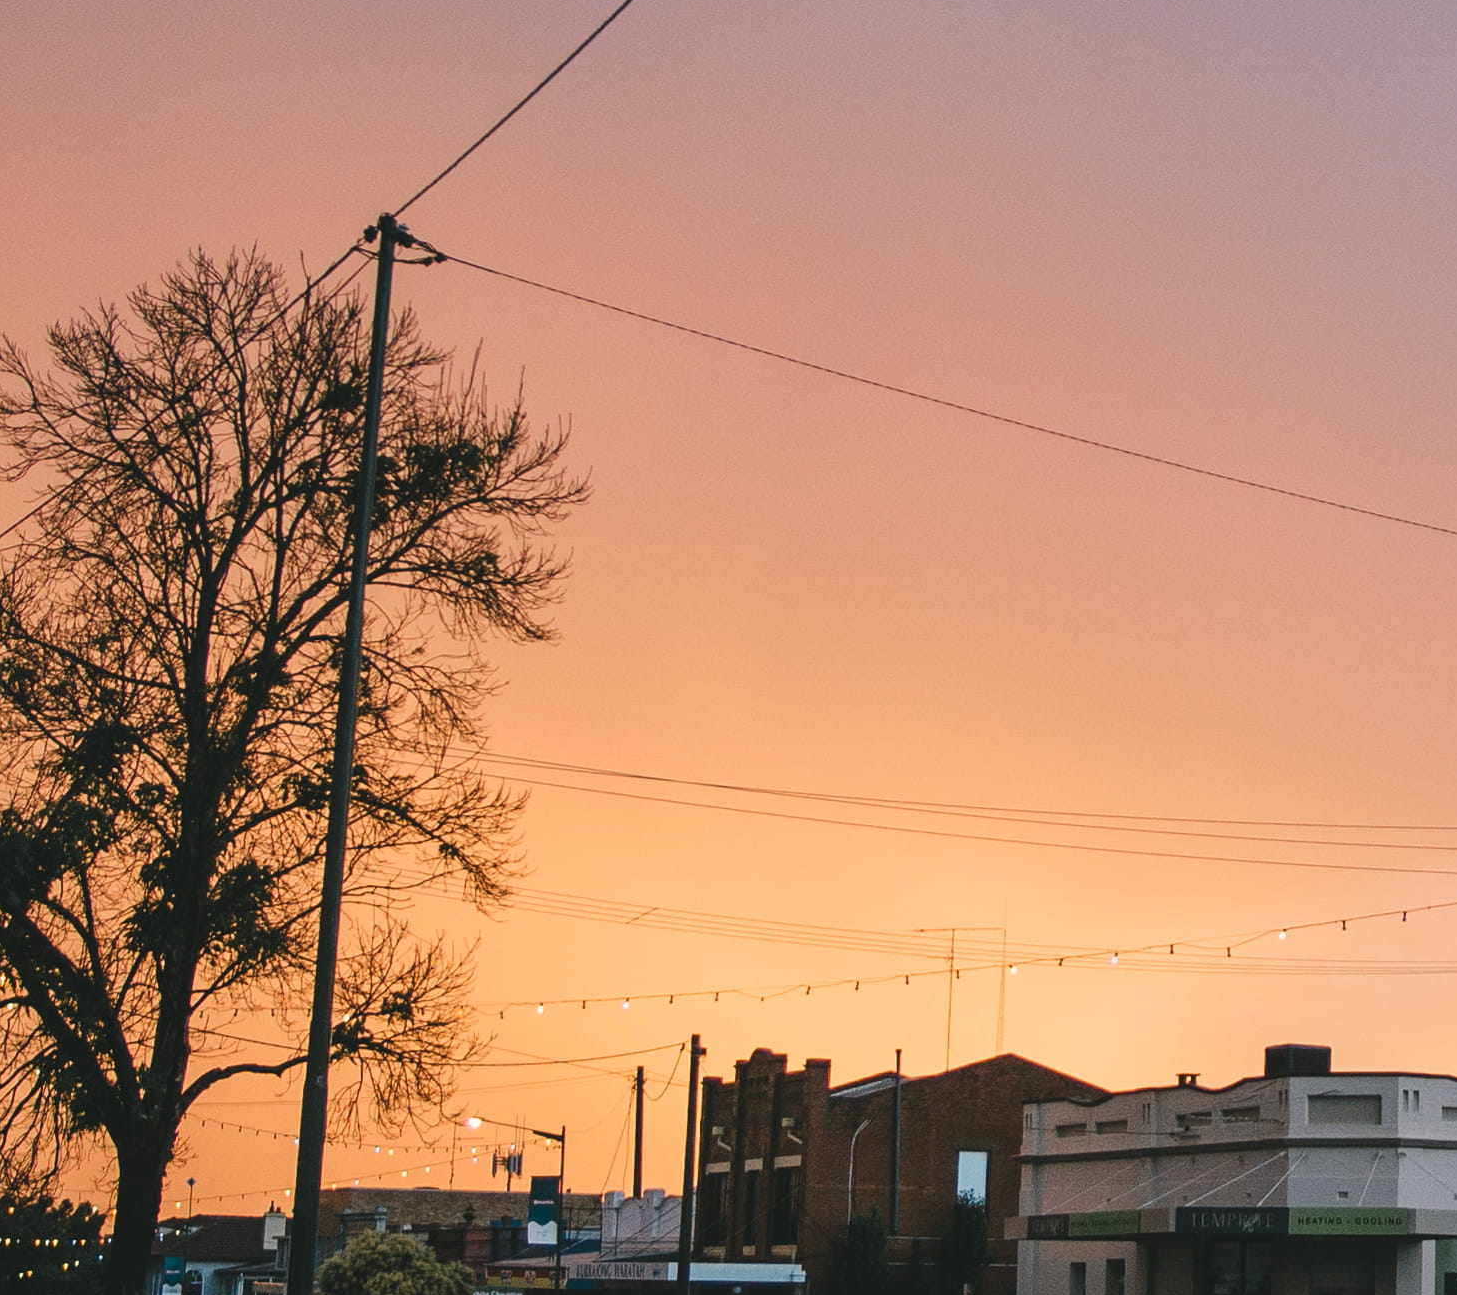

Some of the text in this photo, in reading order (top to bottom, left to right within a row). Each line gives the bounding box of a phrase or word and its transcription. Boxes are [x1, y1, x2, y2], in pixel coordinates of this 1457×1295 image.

[1191, 1212, 1276, 1228] TEMPRTE
[1297, 1216, 1403, 1226] HEATING COOLING
[614, 1264, 646, 1278] WARATAH
